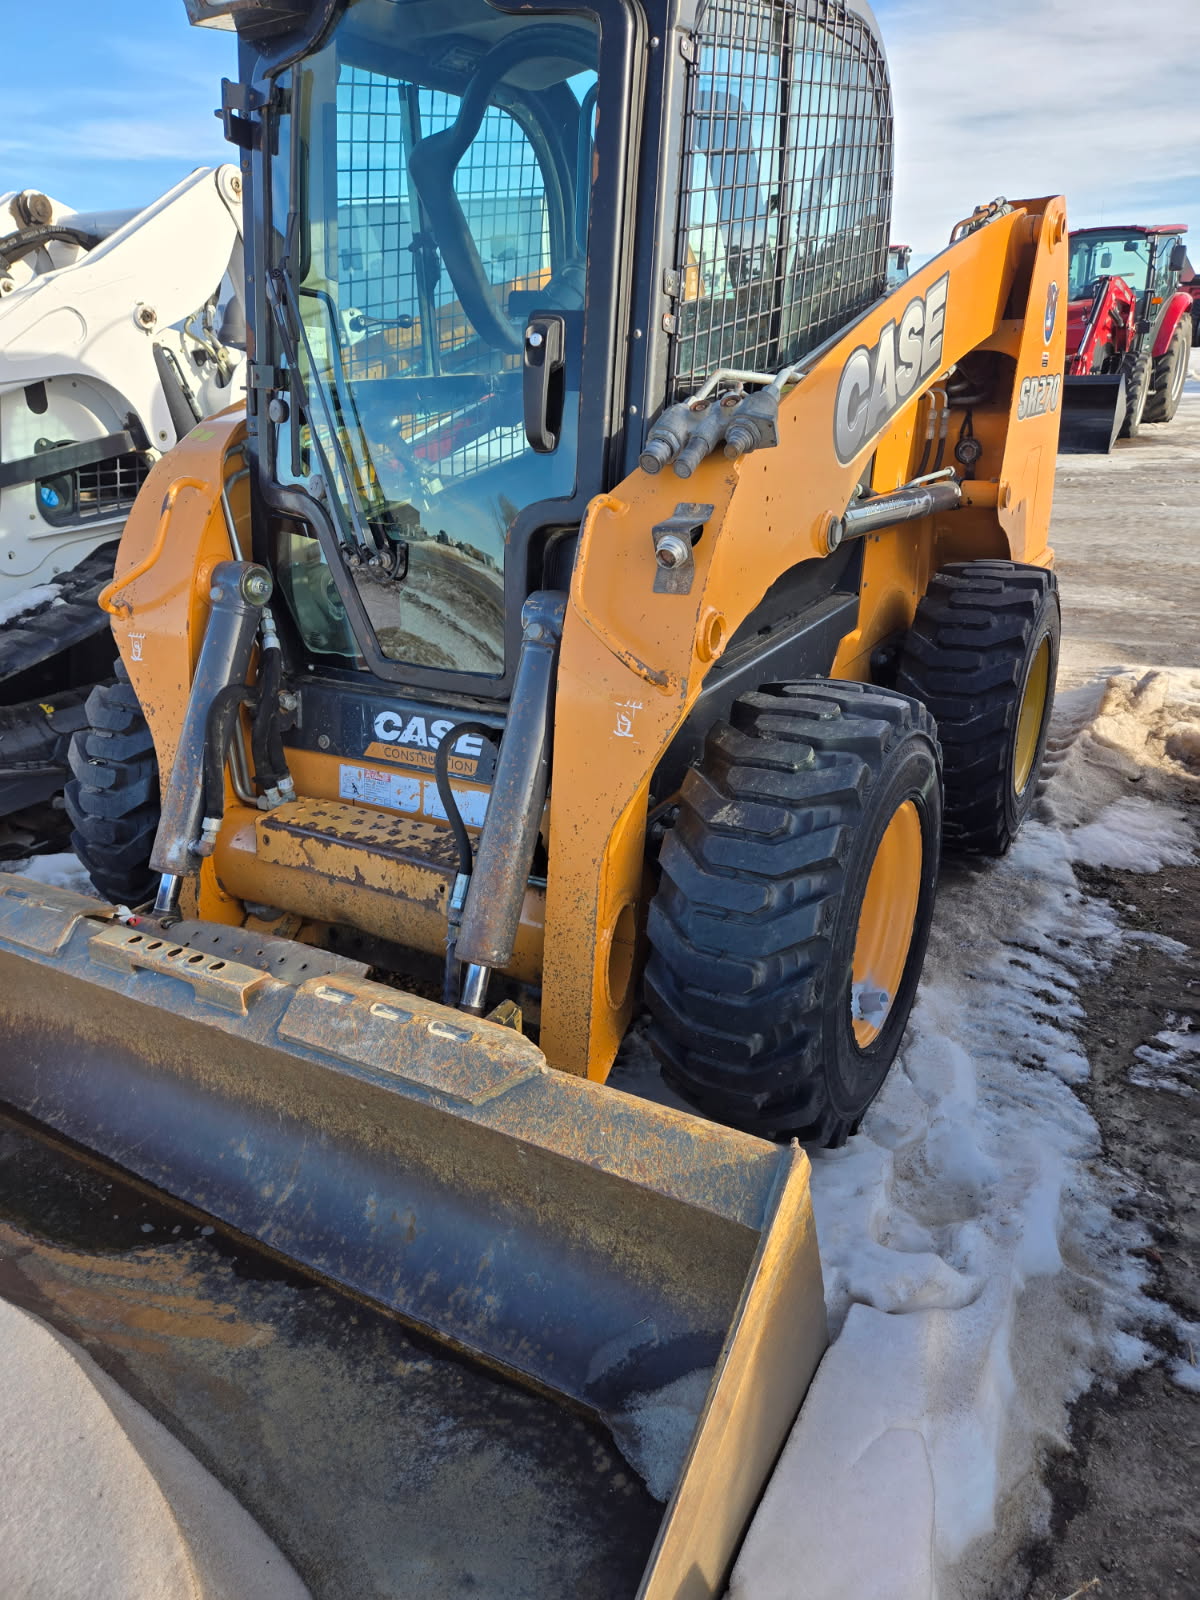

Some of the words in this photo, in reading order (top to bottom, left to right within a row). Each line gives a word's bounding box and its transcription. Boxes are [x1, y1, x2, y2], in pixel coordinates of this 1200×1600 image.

[833, 270, 950, 466] CASE
[1018, 374, 1061, 420] SR270
[374, 710, 484, 757] CASE
[383, 747, 474, 773] CONSTRUION
